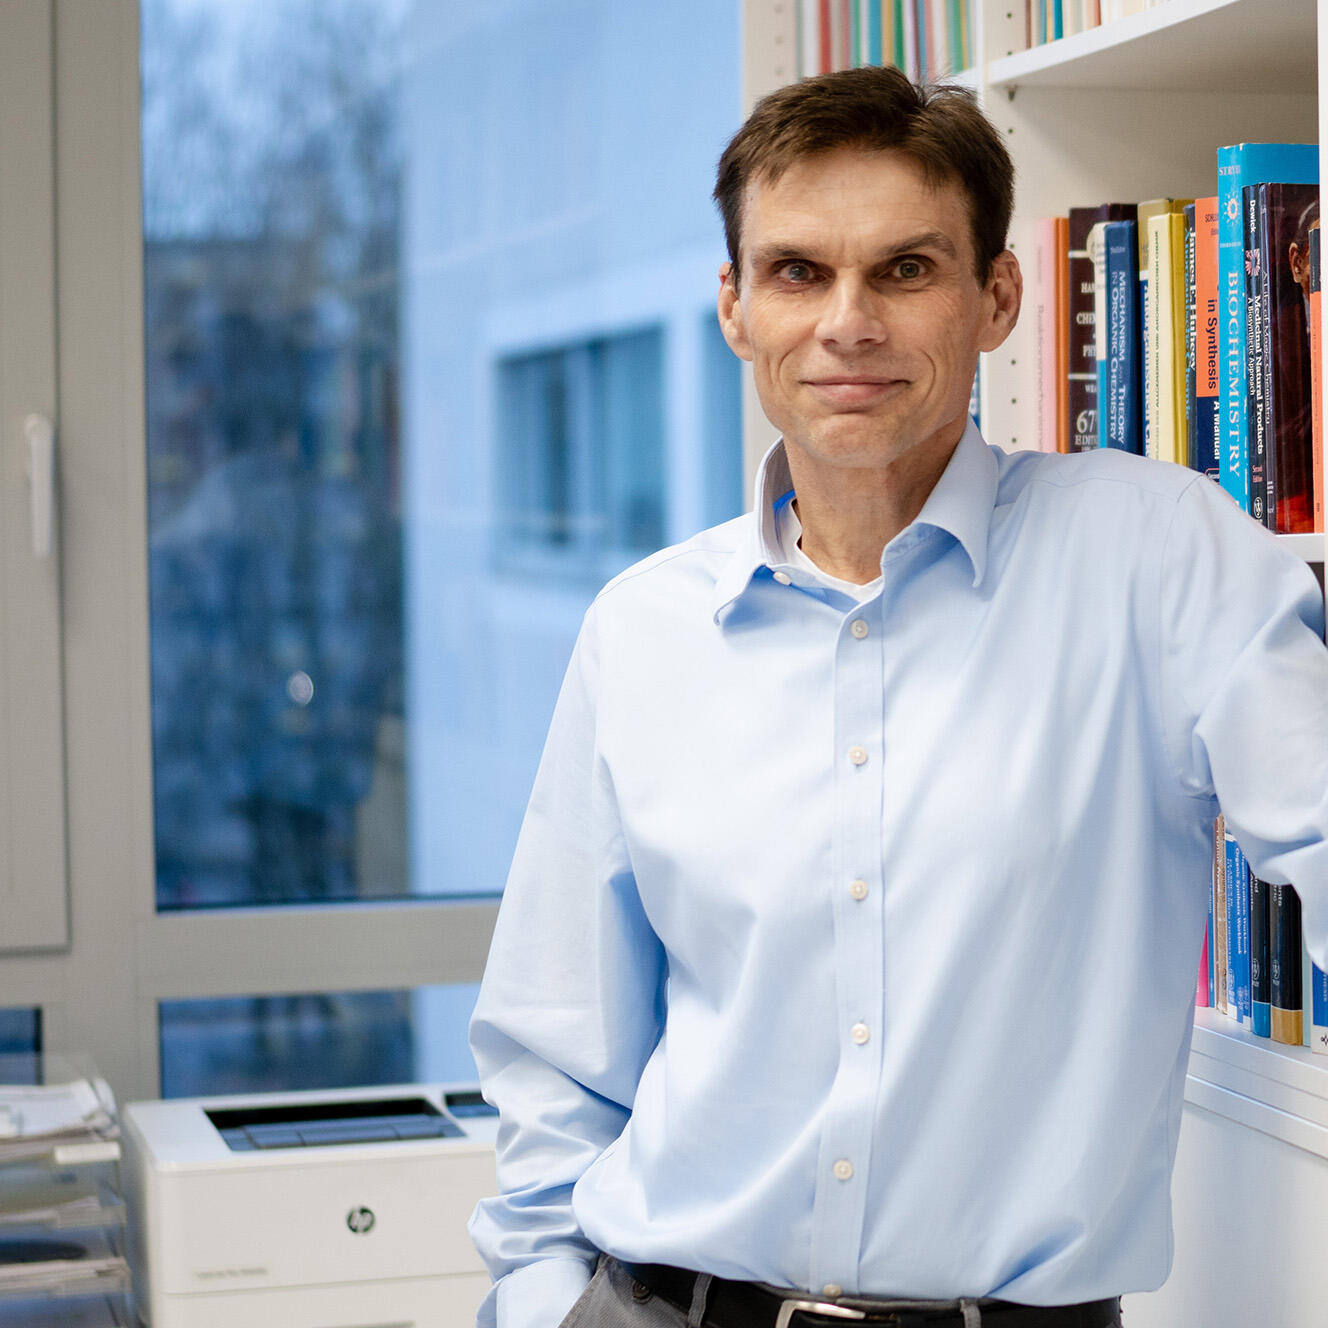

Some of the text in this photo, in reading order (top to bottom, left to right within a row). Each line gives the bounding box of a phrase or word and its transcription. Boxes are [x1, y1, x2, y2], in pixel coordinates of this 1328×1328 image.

[1110, 287, 1119, 355] ORGANIC
[1118, 271, 1127, 361] MECHANISM
[1206, 299, 1218, 390] in Synthesis
[1110, 357, 1119, 440] CHEMISTRY
[1228, 271, 1240, 477] BIOCHEMISTRY
[1264, 363, 1272, 425] Chemistry
[1117, 385, 1126, 444] THEORY
[1256, 404, 1264, 455] Products
